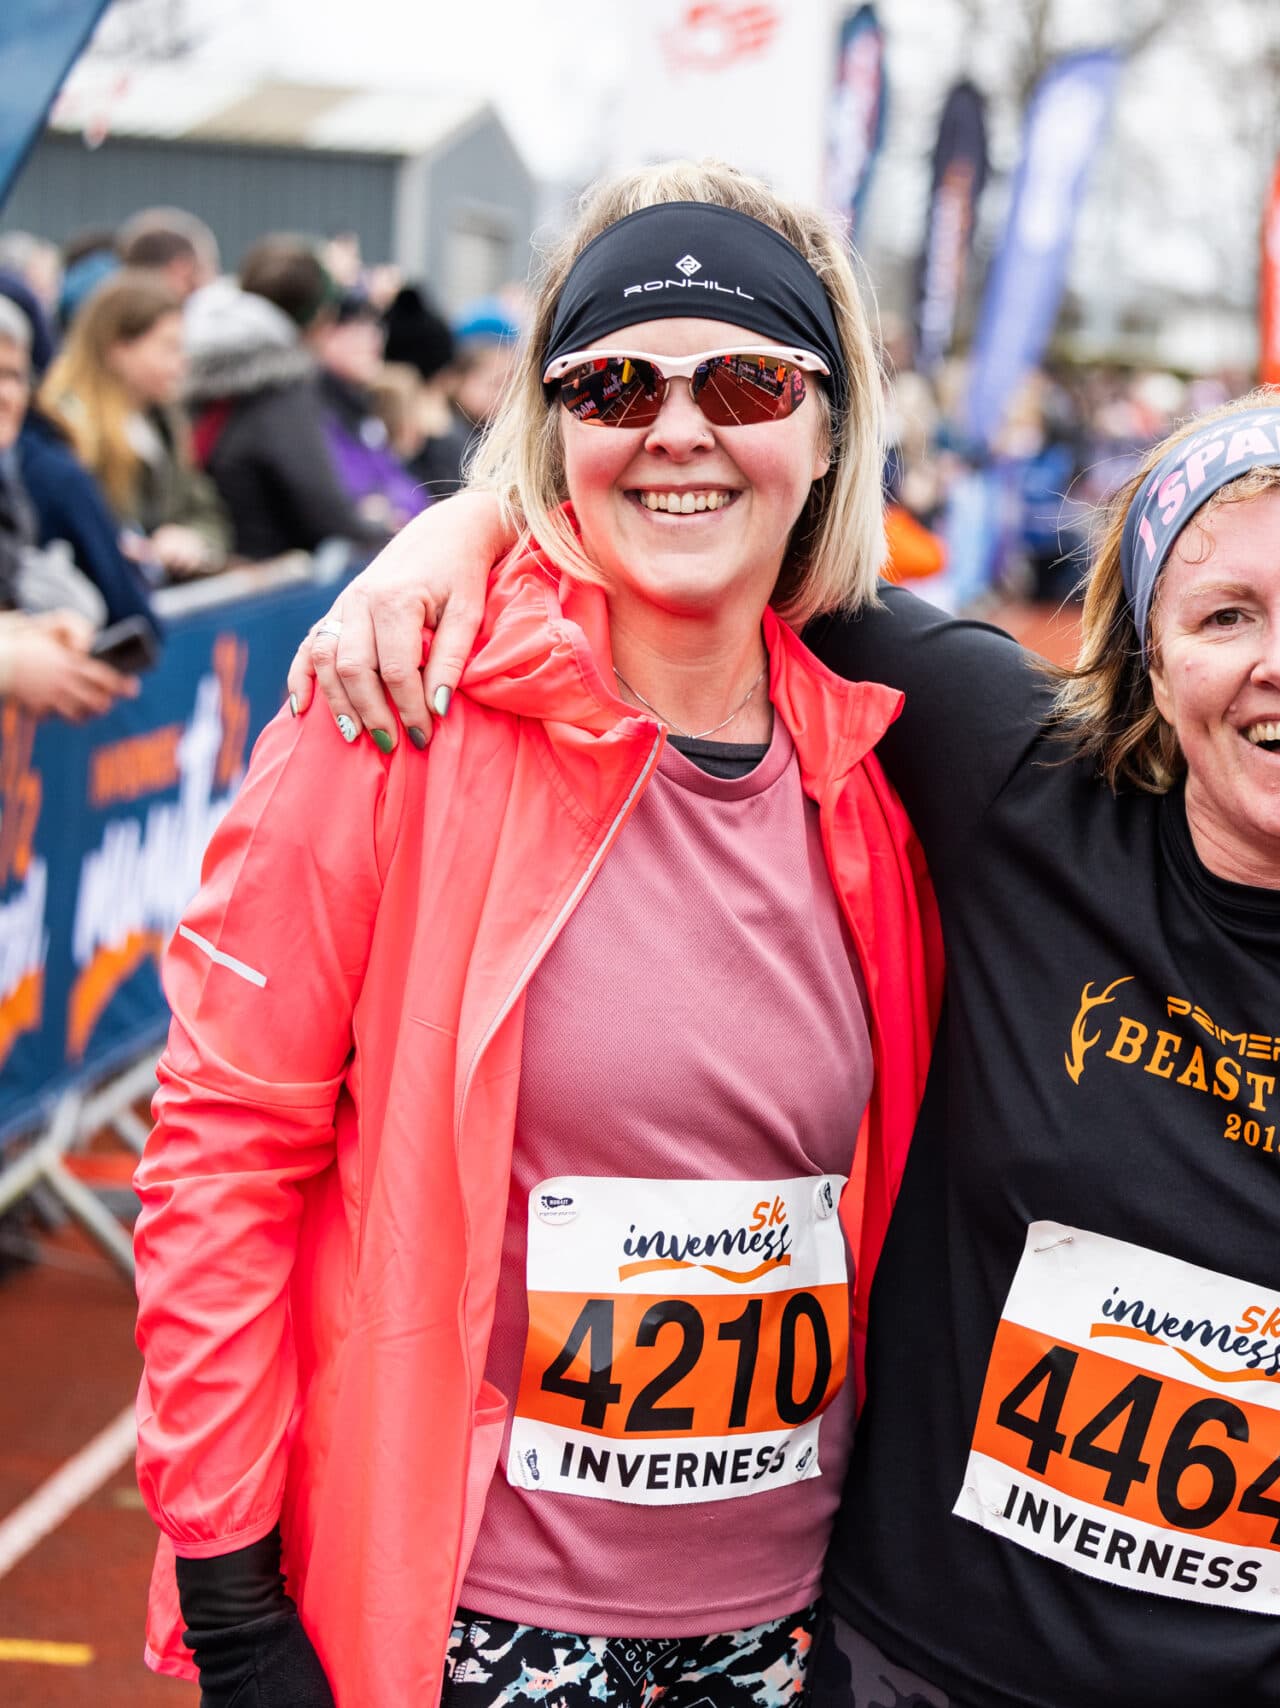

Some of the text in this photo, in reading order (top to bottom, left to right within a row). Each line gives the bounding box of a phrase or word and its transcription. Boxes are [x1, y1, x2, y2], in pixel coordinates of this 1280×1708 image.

[623, 279, 755, 300] RONHILL
[1105, 1016, 1276, 1112] BEAST
[623, 1224, 793, 1262] inverness
[540, 1292, 832, 1432] 4210
[560, 1441, 791, 1490] INVERNESS
[1002, 1484, 1263, 1593] INVERNESS
